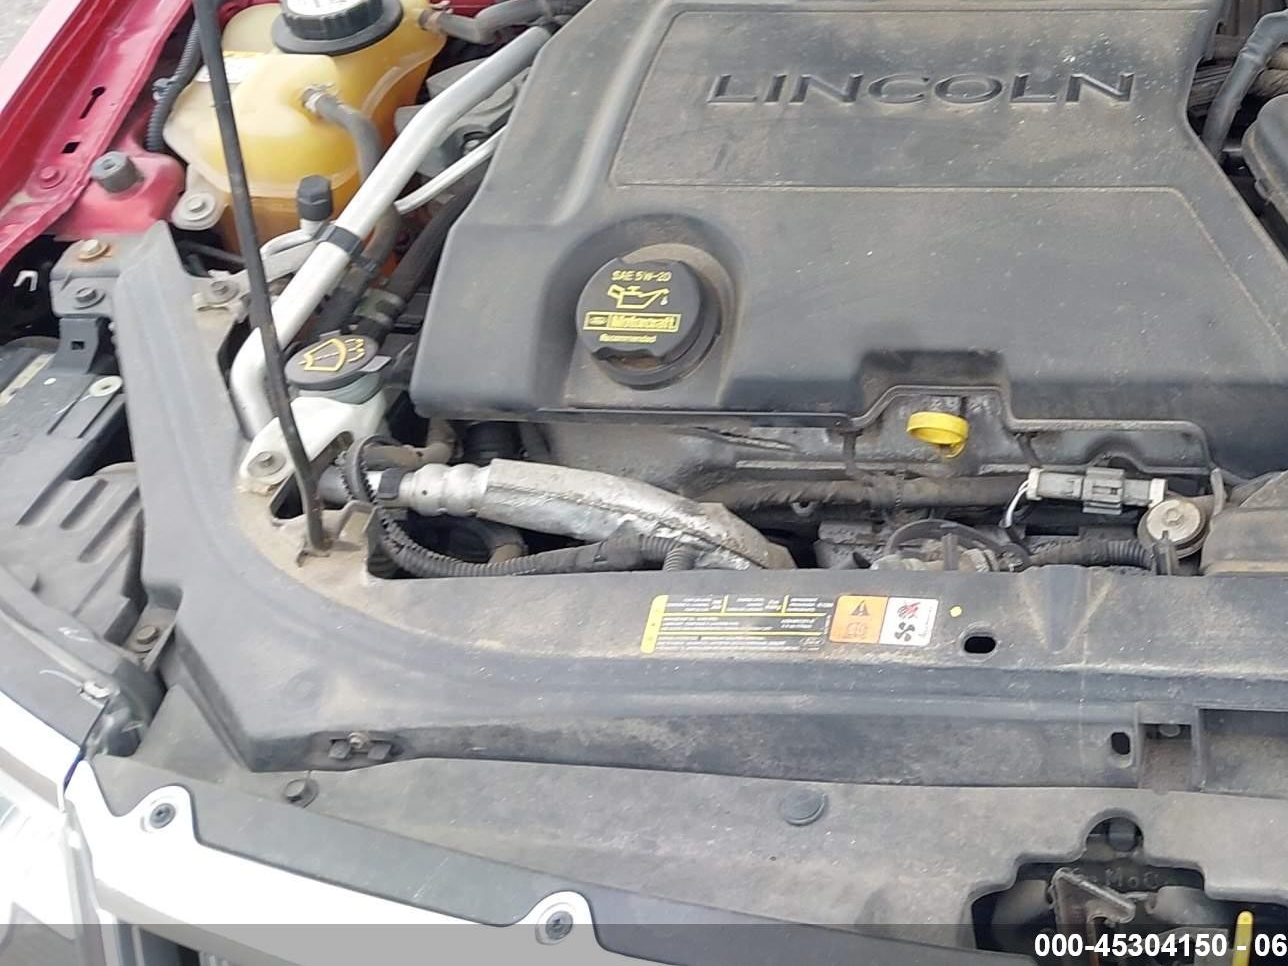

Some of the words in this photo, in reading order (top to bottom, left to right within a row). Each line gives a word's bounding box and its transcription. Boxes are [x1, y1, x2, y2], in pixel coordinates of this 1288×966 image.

[706, 73, 1137, 105] LINCOLN
[611, 270, 635, 281] SAE
[635, 271, 673, 282] 5W-20
